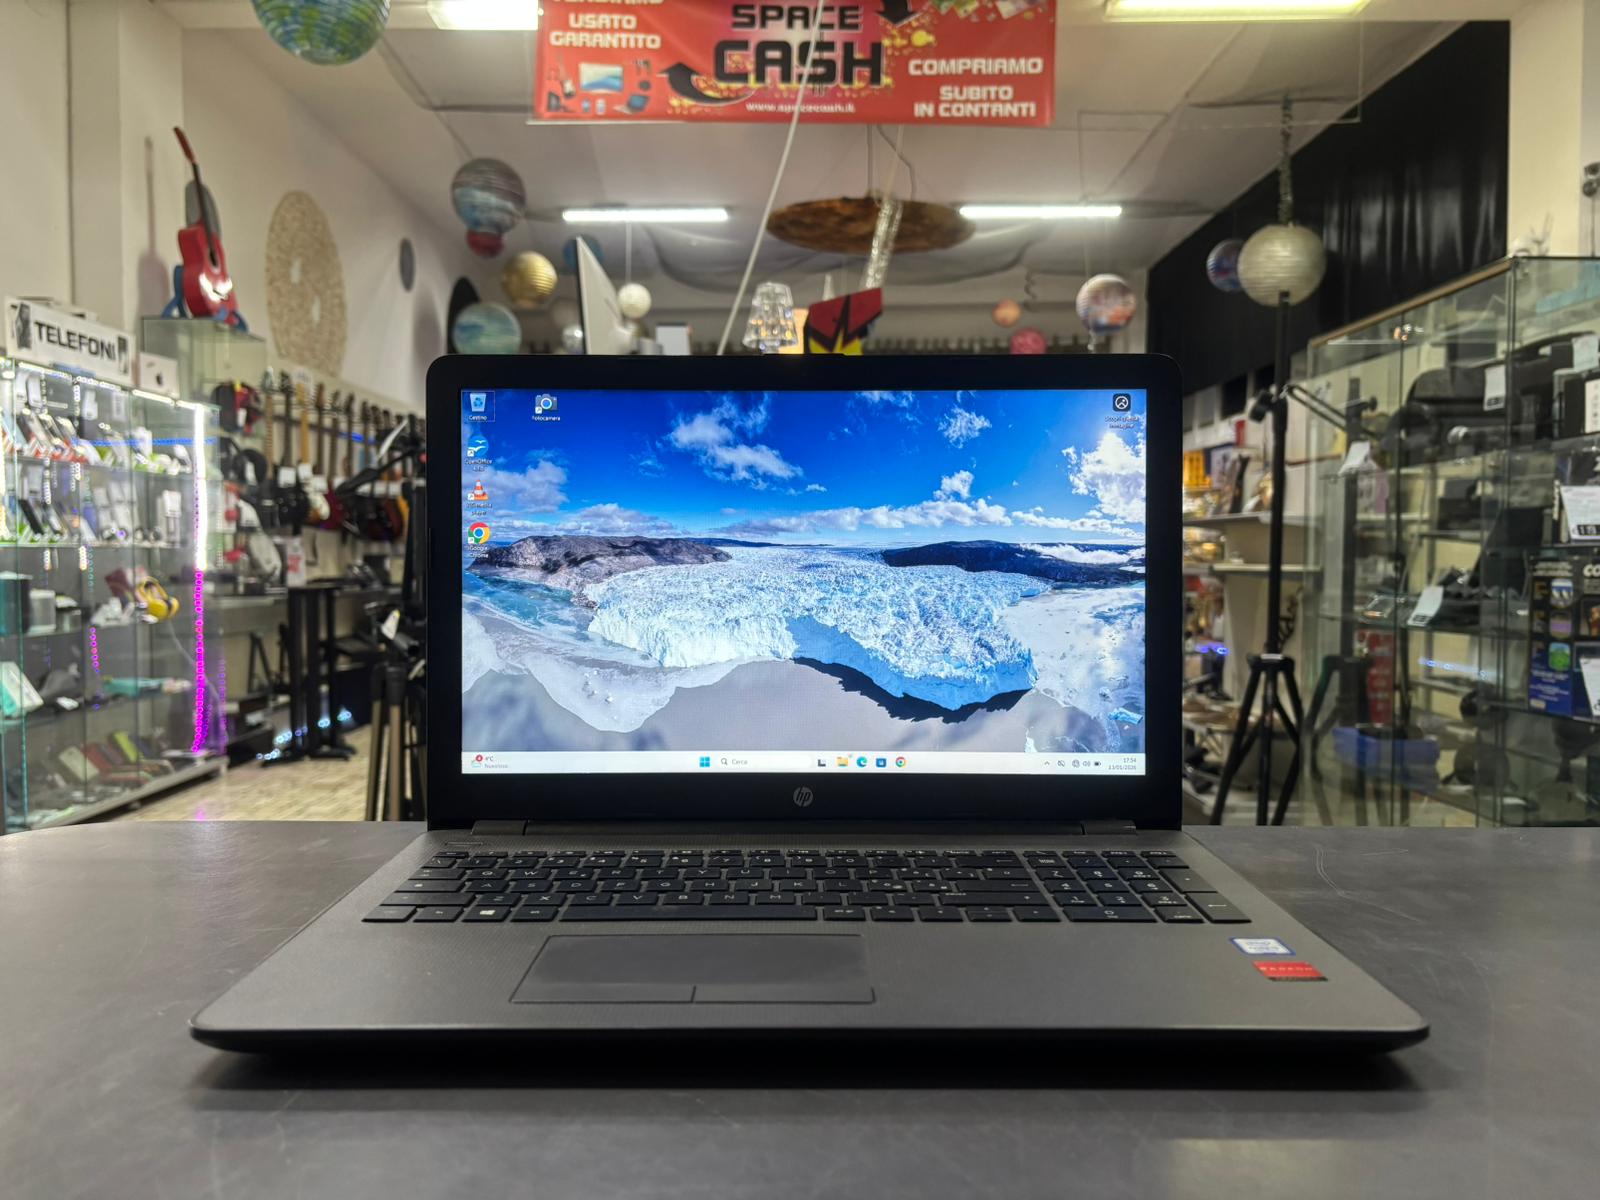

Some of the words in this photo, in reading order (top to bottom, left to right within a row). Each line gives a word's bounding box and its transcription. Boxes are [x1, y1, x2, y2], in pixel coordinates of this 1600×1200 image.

[569, 13, 637, 29] USATO
[732, 4, 861, 31] SPACE
[550, 31, 661, 48] GARANTITO
[715, 40, 883, 86] CASH
[908, 57, 1044, 75] COMPRIAMO
[940, 85, 1013, 100] SUBITO
[914, 102, 934, 117] IN
[938, 102, 1037, 117] CONTANTI
[34, 321, 116, 360] TELEFONI
